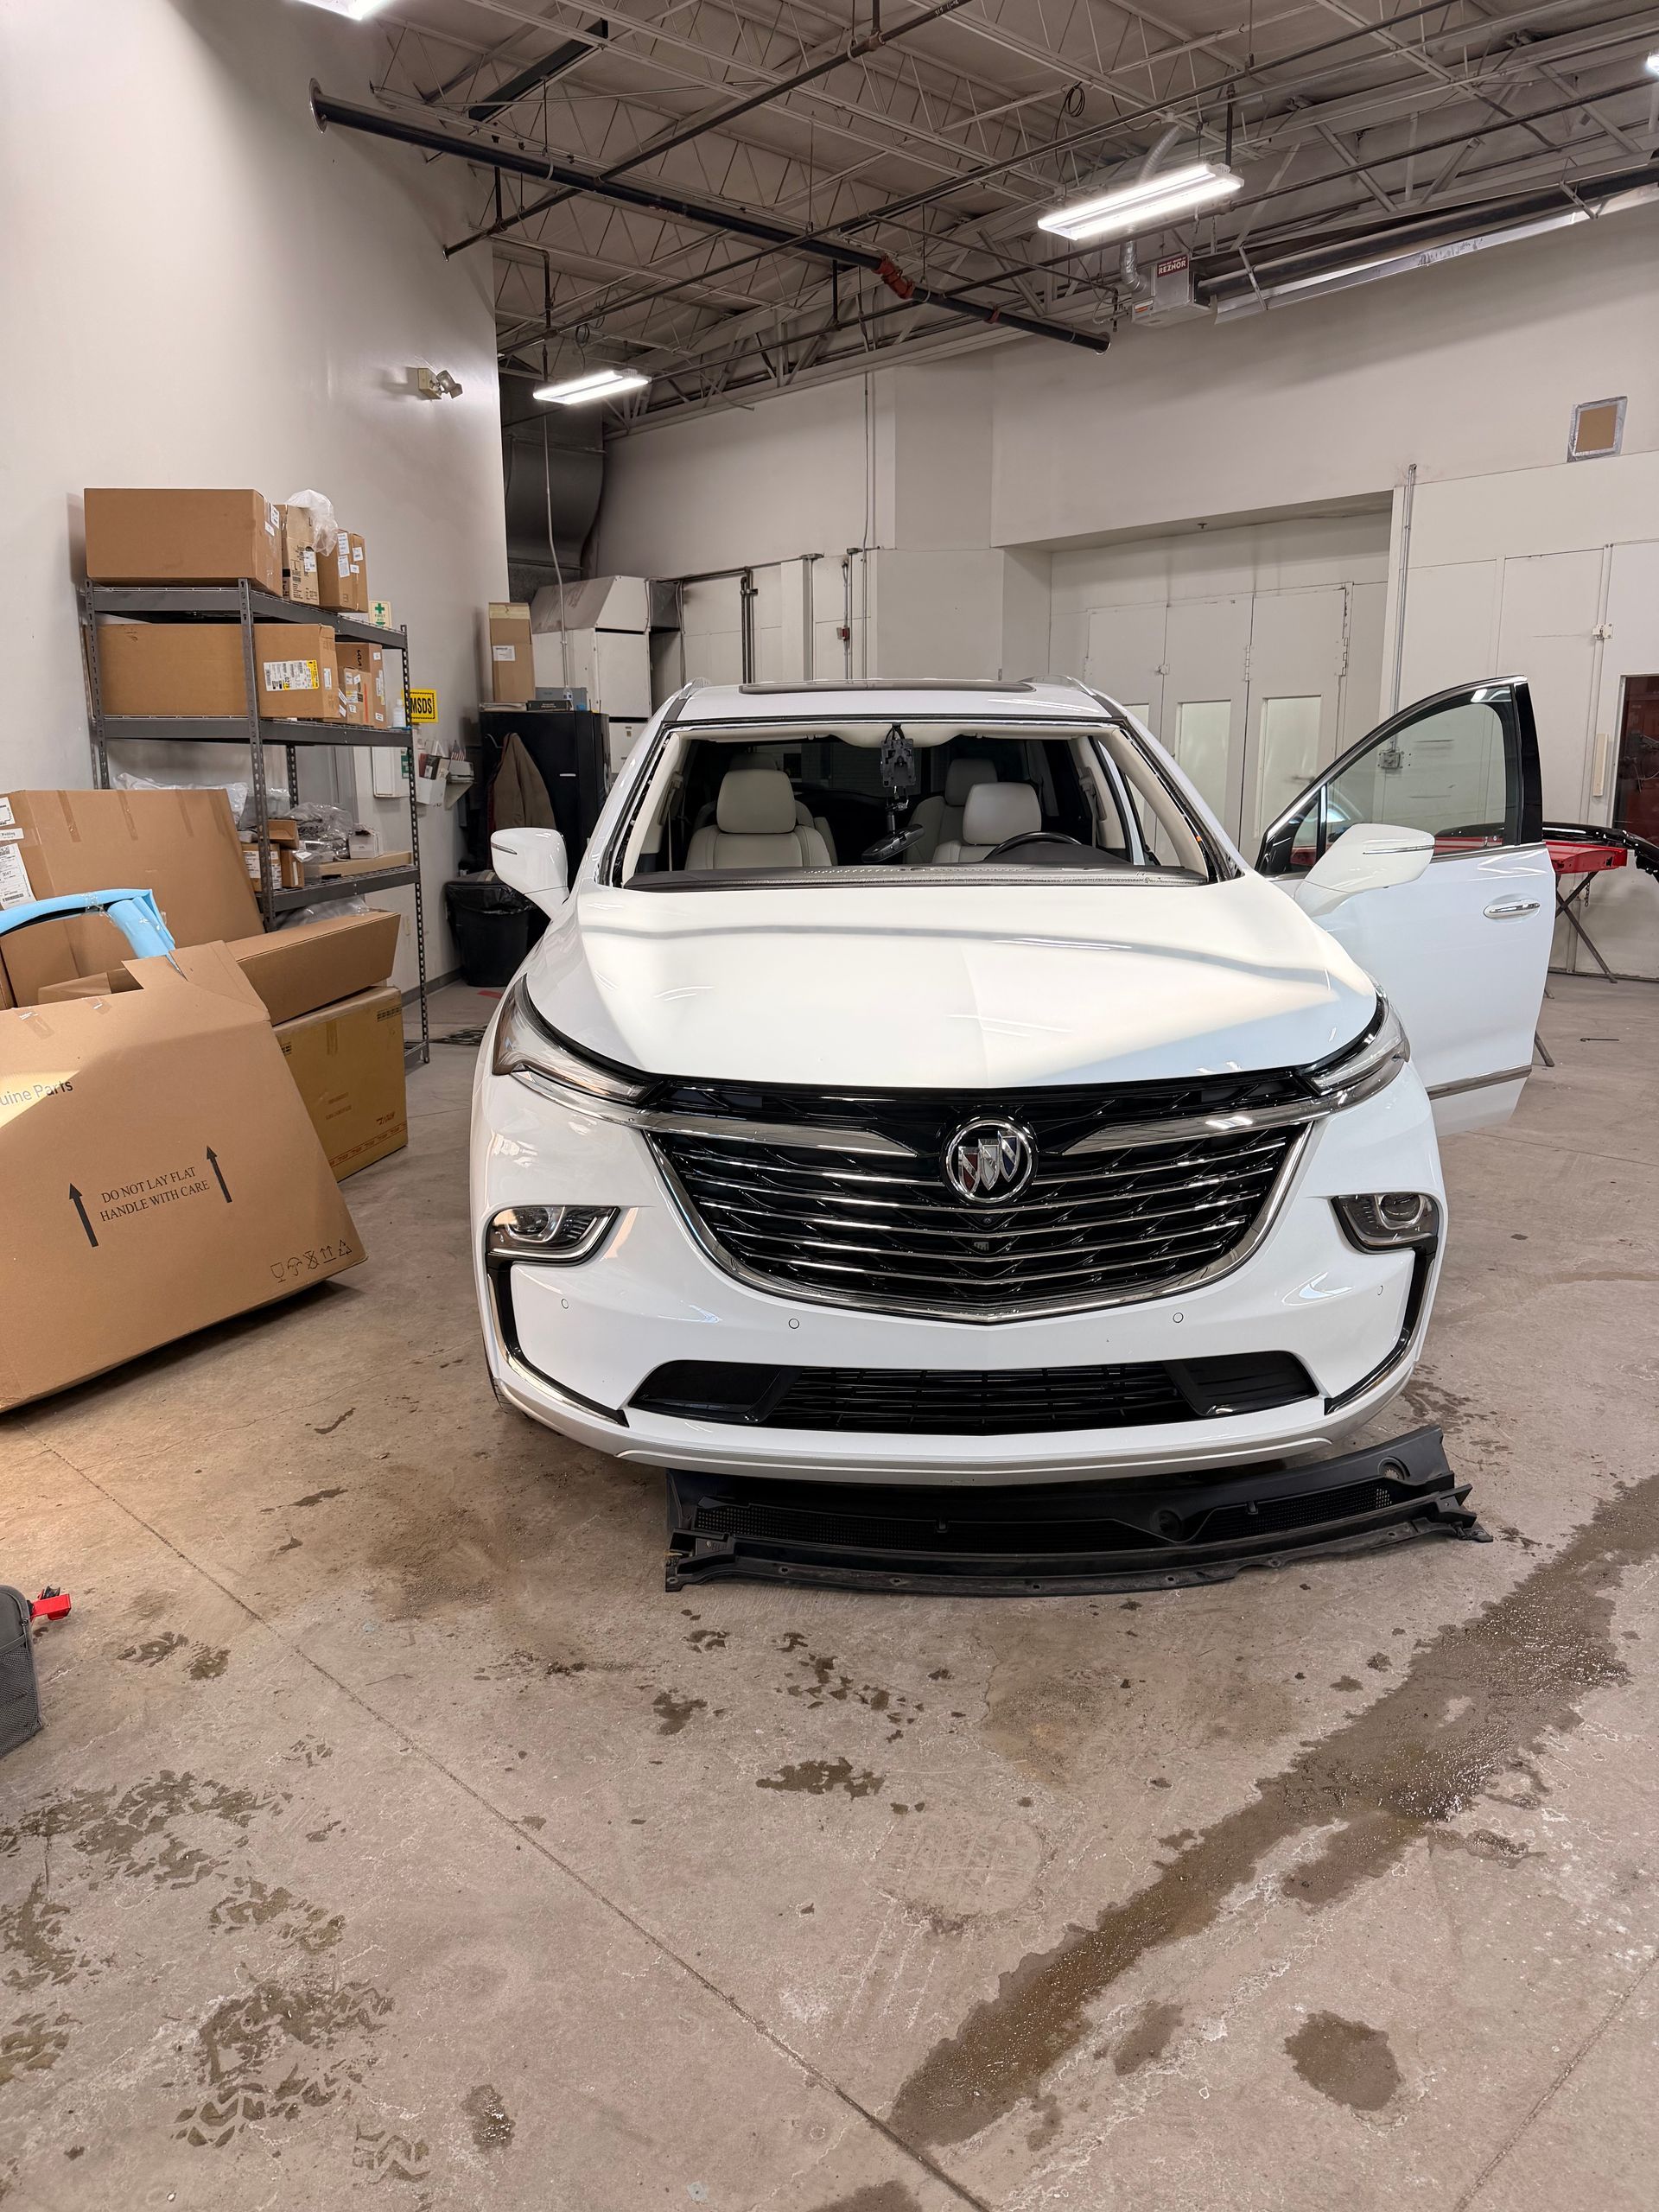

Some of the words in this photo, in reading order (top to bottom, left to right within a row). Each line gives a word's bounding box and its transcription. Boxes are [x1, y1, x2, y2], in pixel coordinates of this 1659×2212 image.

[1158, 261, 1186, 275] REZNOR
[410, 697, 433, 715] MSDS
[33, 1080, 73, 1097] Parts
[101, 1190, 120, 1203] DO
[120, 1182, 145, 1198] NOT
[146, 1174, 168, 1190] LAY
[169, 1166, 196, 1182] FLAT
[99, 1198, 149, 1222] HANDLE
[149, 1189, 180, 1206] WITH
[180, 1179, 210, 1197] CARE
